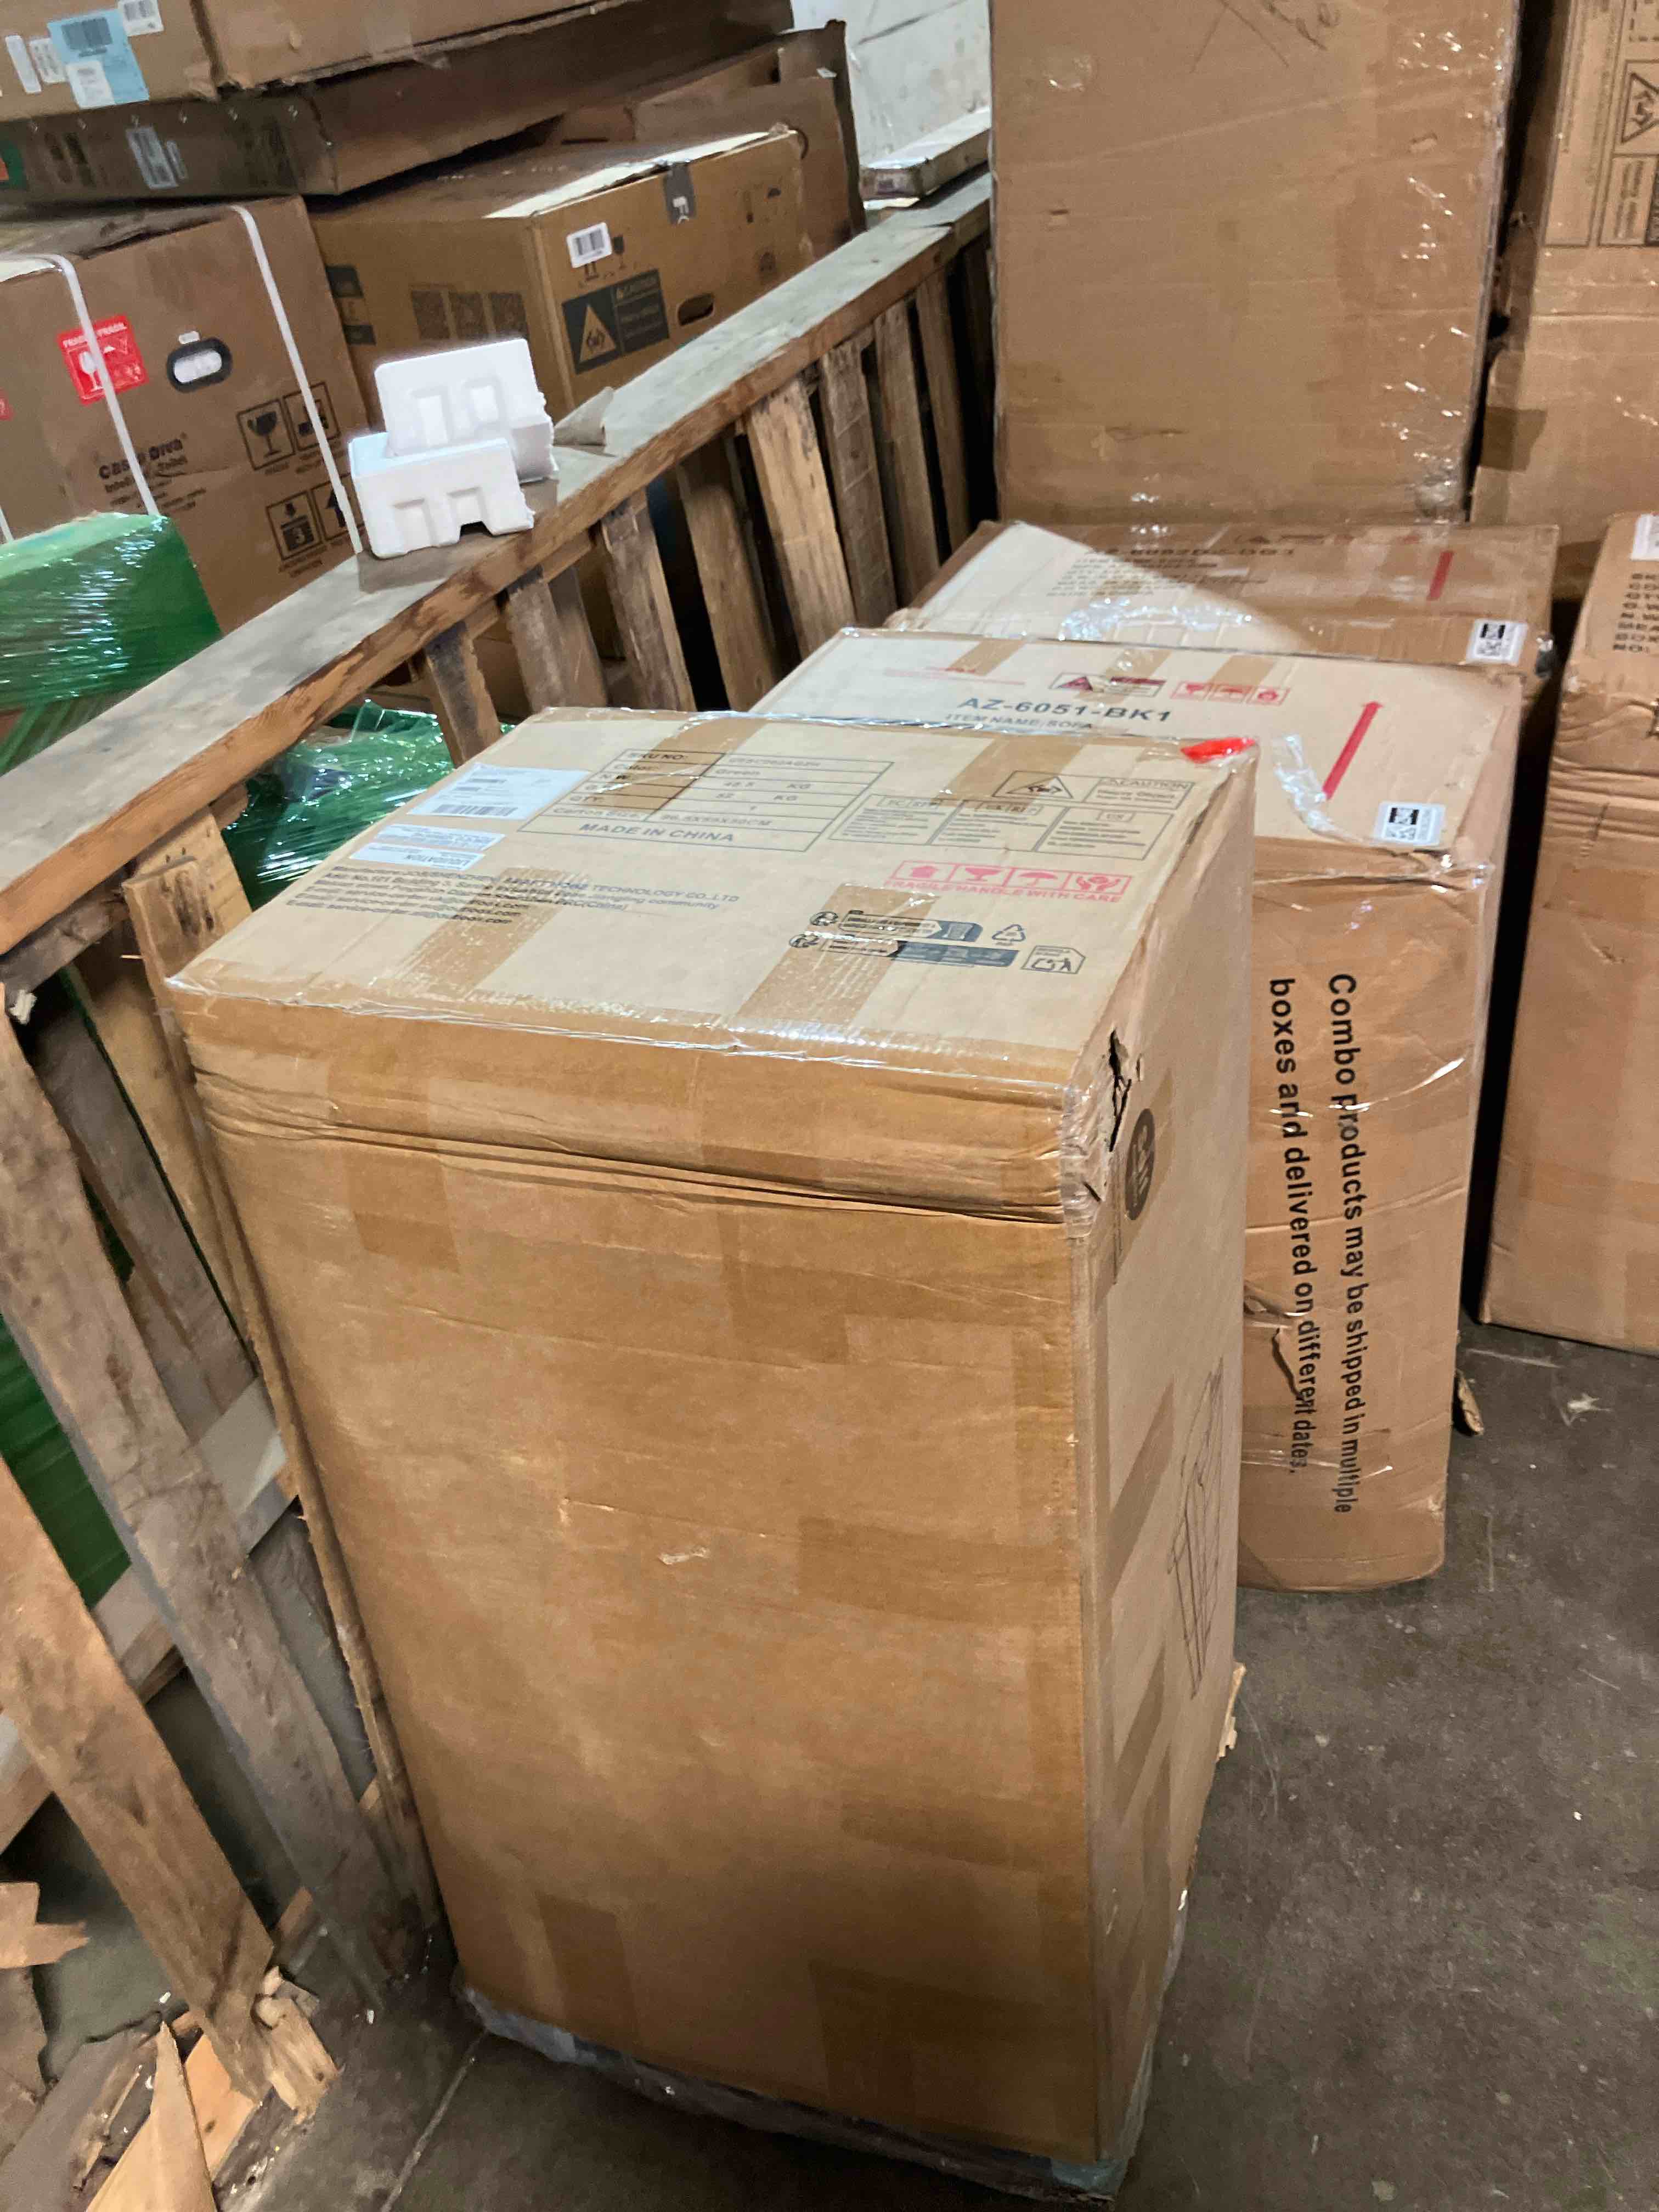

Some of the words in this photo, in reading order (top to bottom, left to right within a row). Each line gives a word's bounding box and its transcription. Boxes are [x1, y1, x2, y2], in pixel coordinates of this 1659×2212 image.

[958, 697, 1173, 722] AZ-6051-BK1
[579, 823, 637, 835] MADE
[643, 828, 661, 837] IN
[669, 830, 734, 842] CHINA
[883, 880, 955, 892] FRAGILE
[956, 884, 1025, 897] HANDLE
[1026, 889, 1070, 900] WITH
[1073, 892, 1125, 903] CARE
[1269, 978, 1297, 1074] boxes
[1328, 974, 1361, 1085] Combo
[1278, 1083, 1308, 1138] and
[1331, 1093, 1368, 1221] products
[1284, 1146, 1318, 1276] delivered
[1340, 1226, 1364, 1278] may
[1294, 1282, 1314, 1313] on
[1346, 1282, 1370, 1314] be
[1293, 1319, 1321, 1417] different
[1341, 1319, 1369, 1412] shipped
[1341, 1413, 1366, 1435] in
[1334, 1438, 1362, 1514] multiple
